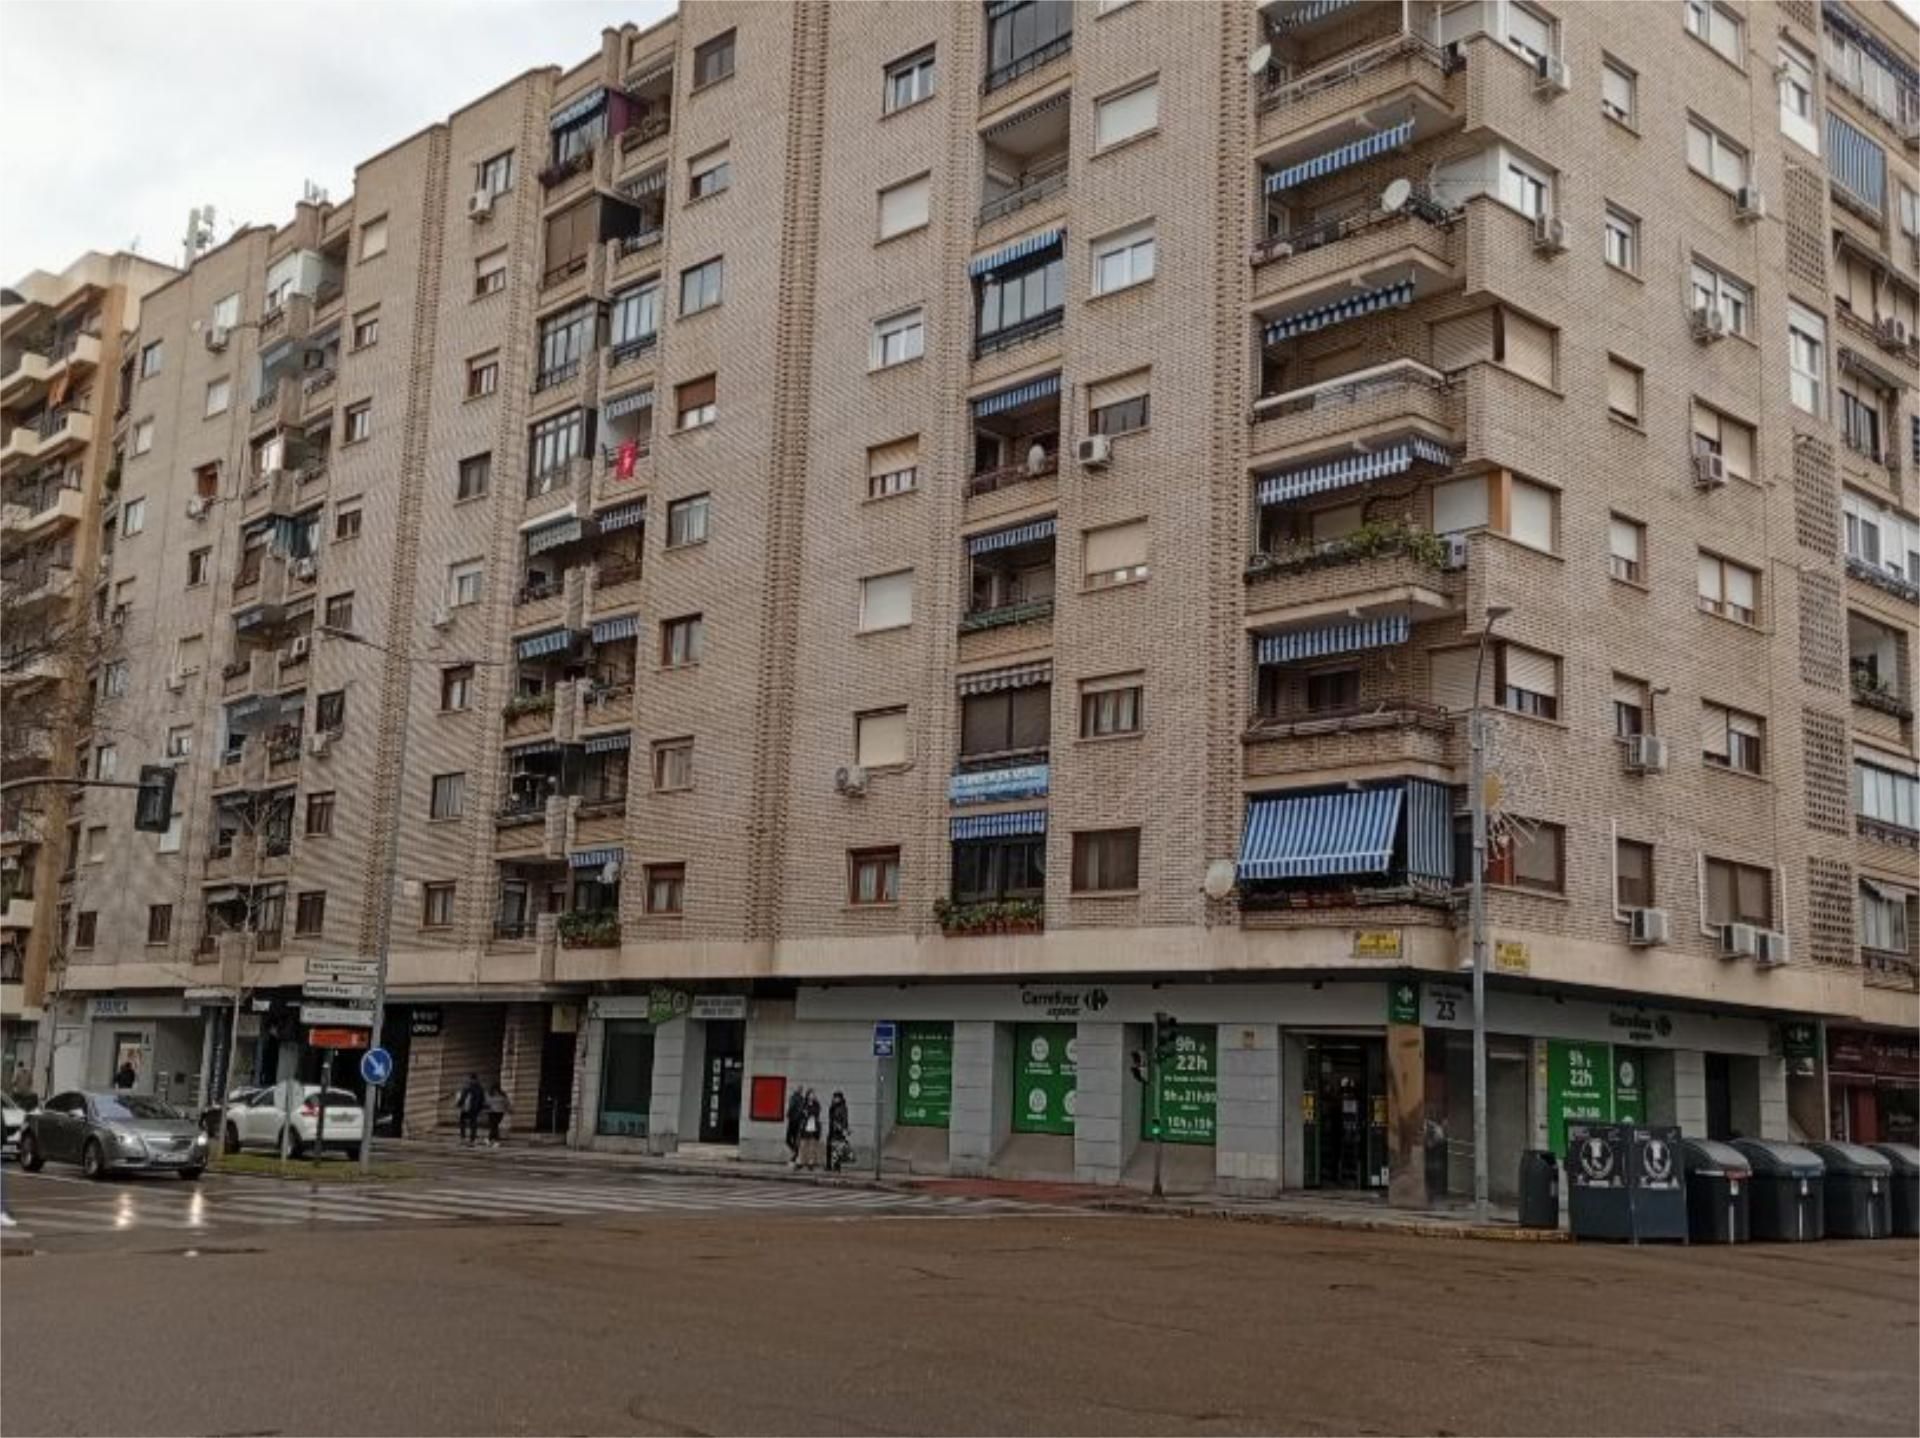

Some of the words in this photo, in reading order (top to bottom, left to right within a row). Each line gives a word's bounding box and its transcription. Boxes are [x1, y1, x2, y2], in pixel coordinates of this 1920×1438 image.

[1022, 991, 1079, 1006] Carrefour
[1436, 1000, 1456, 1021] 23
[1175, 1036, 1196, 1052] 9h
[1175, 1055, 1208, 1072] 22h
[1570, 1069, 1593, 1087] 22h
